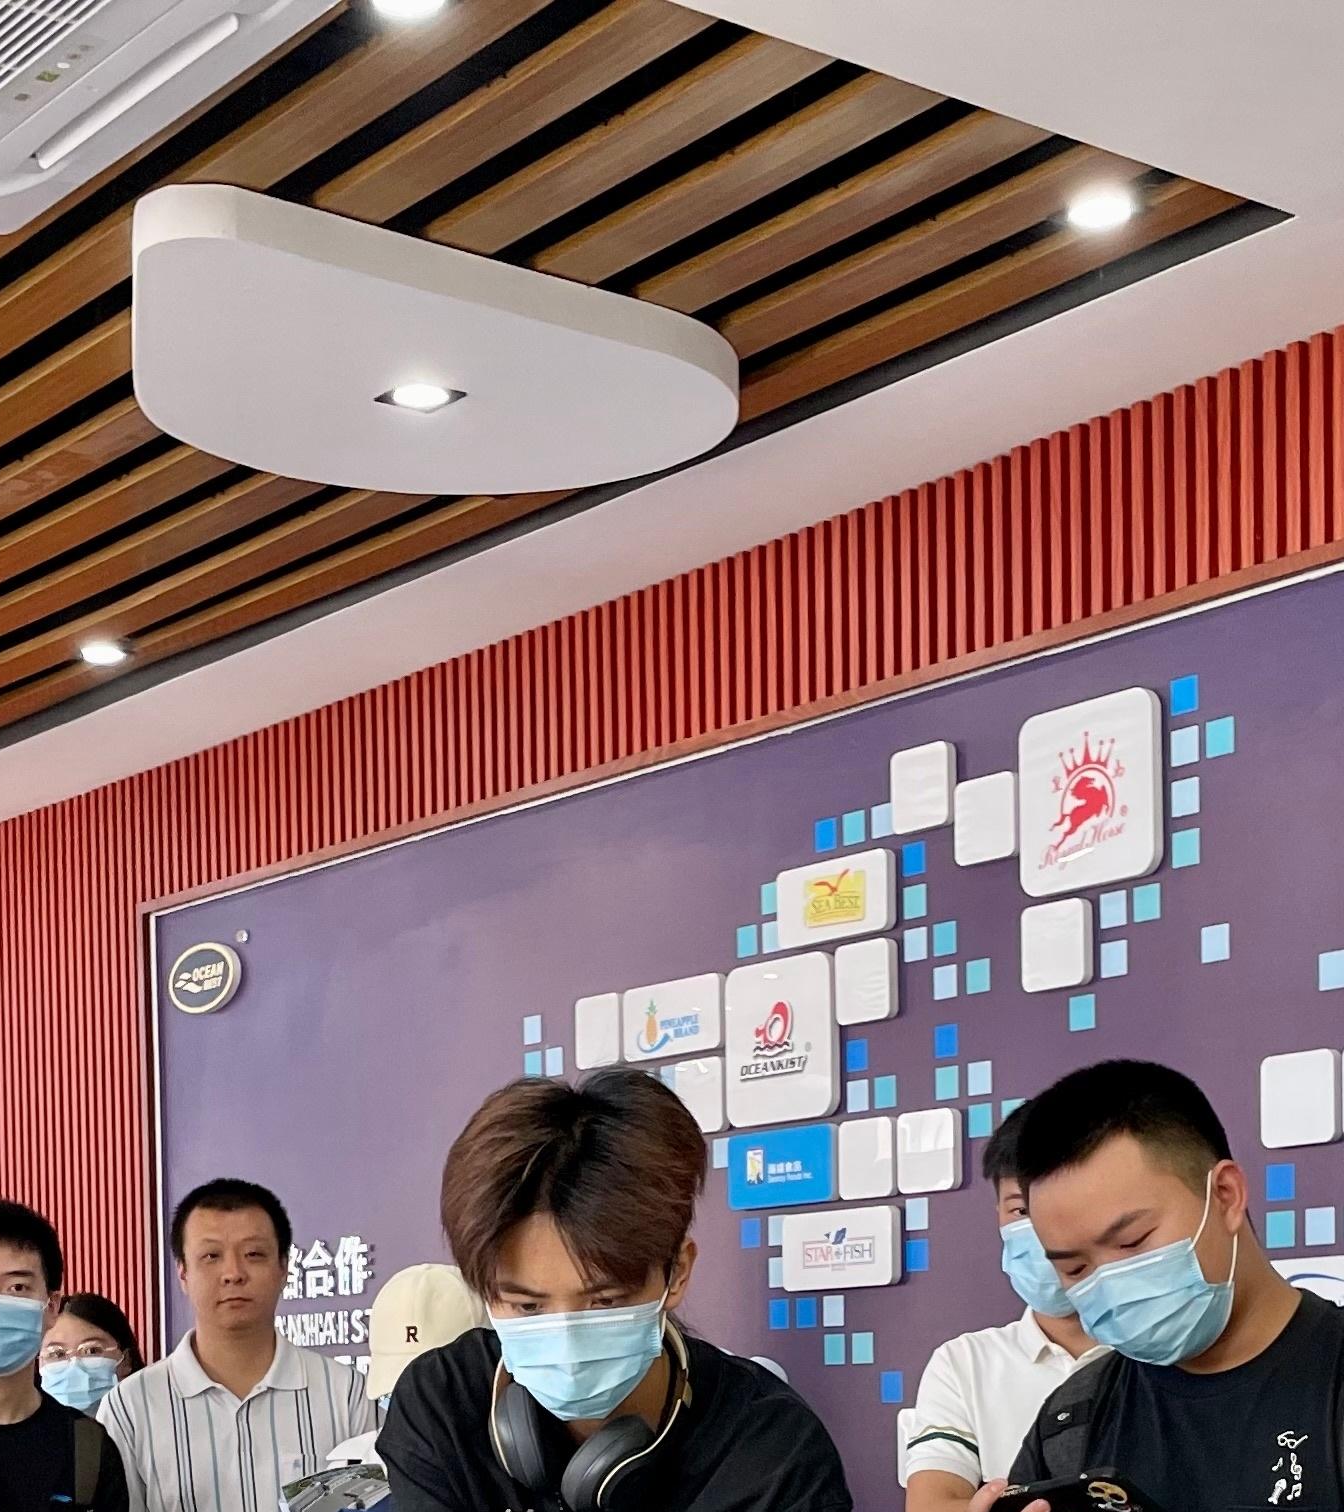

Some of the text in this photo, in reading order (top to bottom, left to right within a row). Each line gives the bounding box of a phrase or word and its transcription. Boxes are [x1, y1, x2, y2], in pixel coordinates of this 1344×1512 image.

[659, 1014, 700, 1031] PINEAPPLE
[740, 1055, 807, 1078] OCEANKIST
[805, 1241, 873, 1263] STAR FISH
[406, 1326, 419, 1343] R
